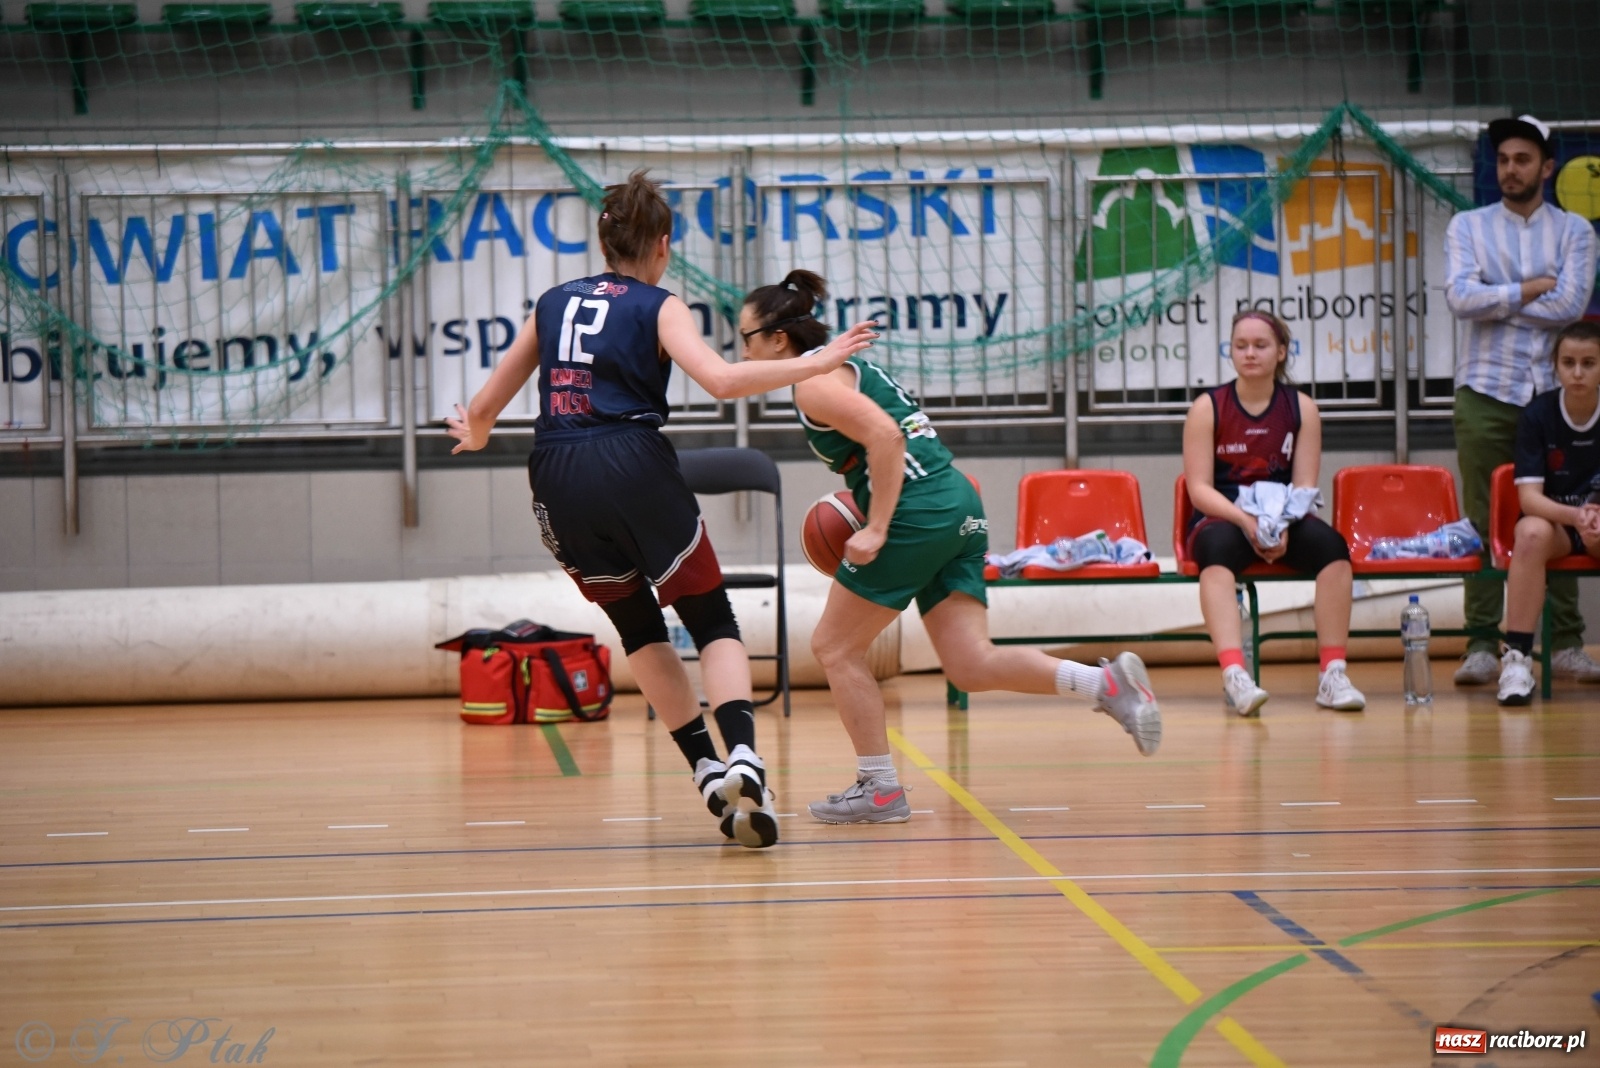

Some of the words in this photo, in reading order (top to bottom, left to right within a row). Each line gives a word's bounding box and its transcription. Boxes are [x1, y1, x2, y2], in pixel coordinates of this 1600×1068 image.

[389, 168, 997, 265] RACORSKI
[558, 296, 610, 365] 12
[1281, 431, 1294, 461] 4
